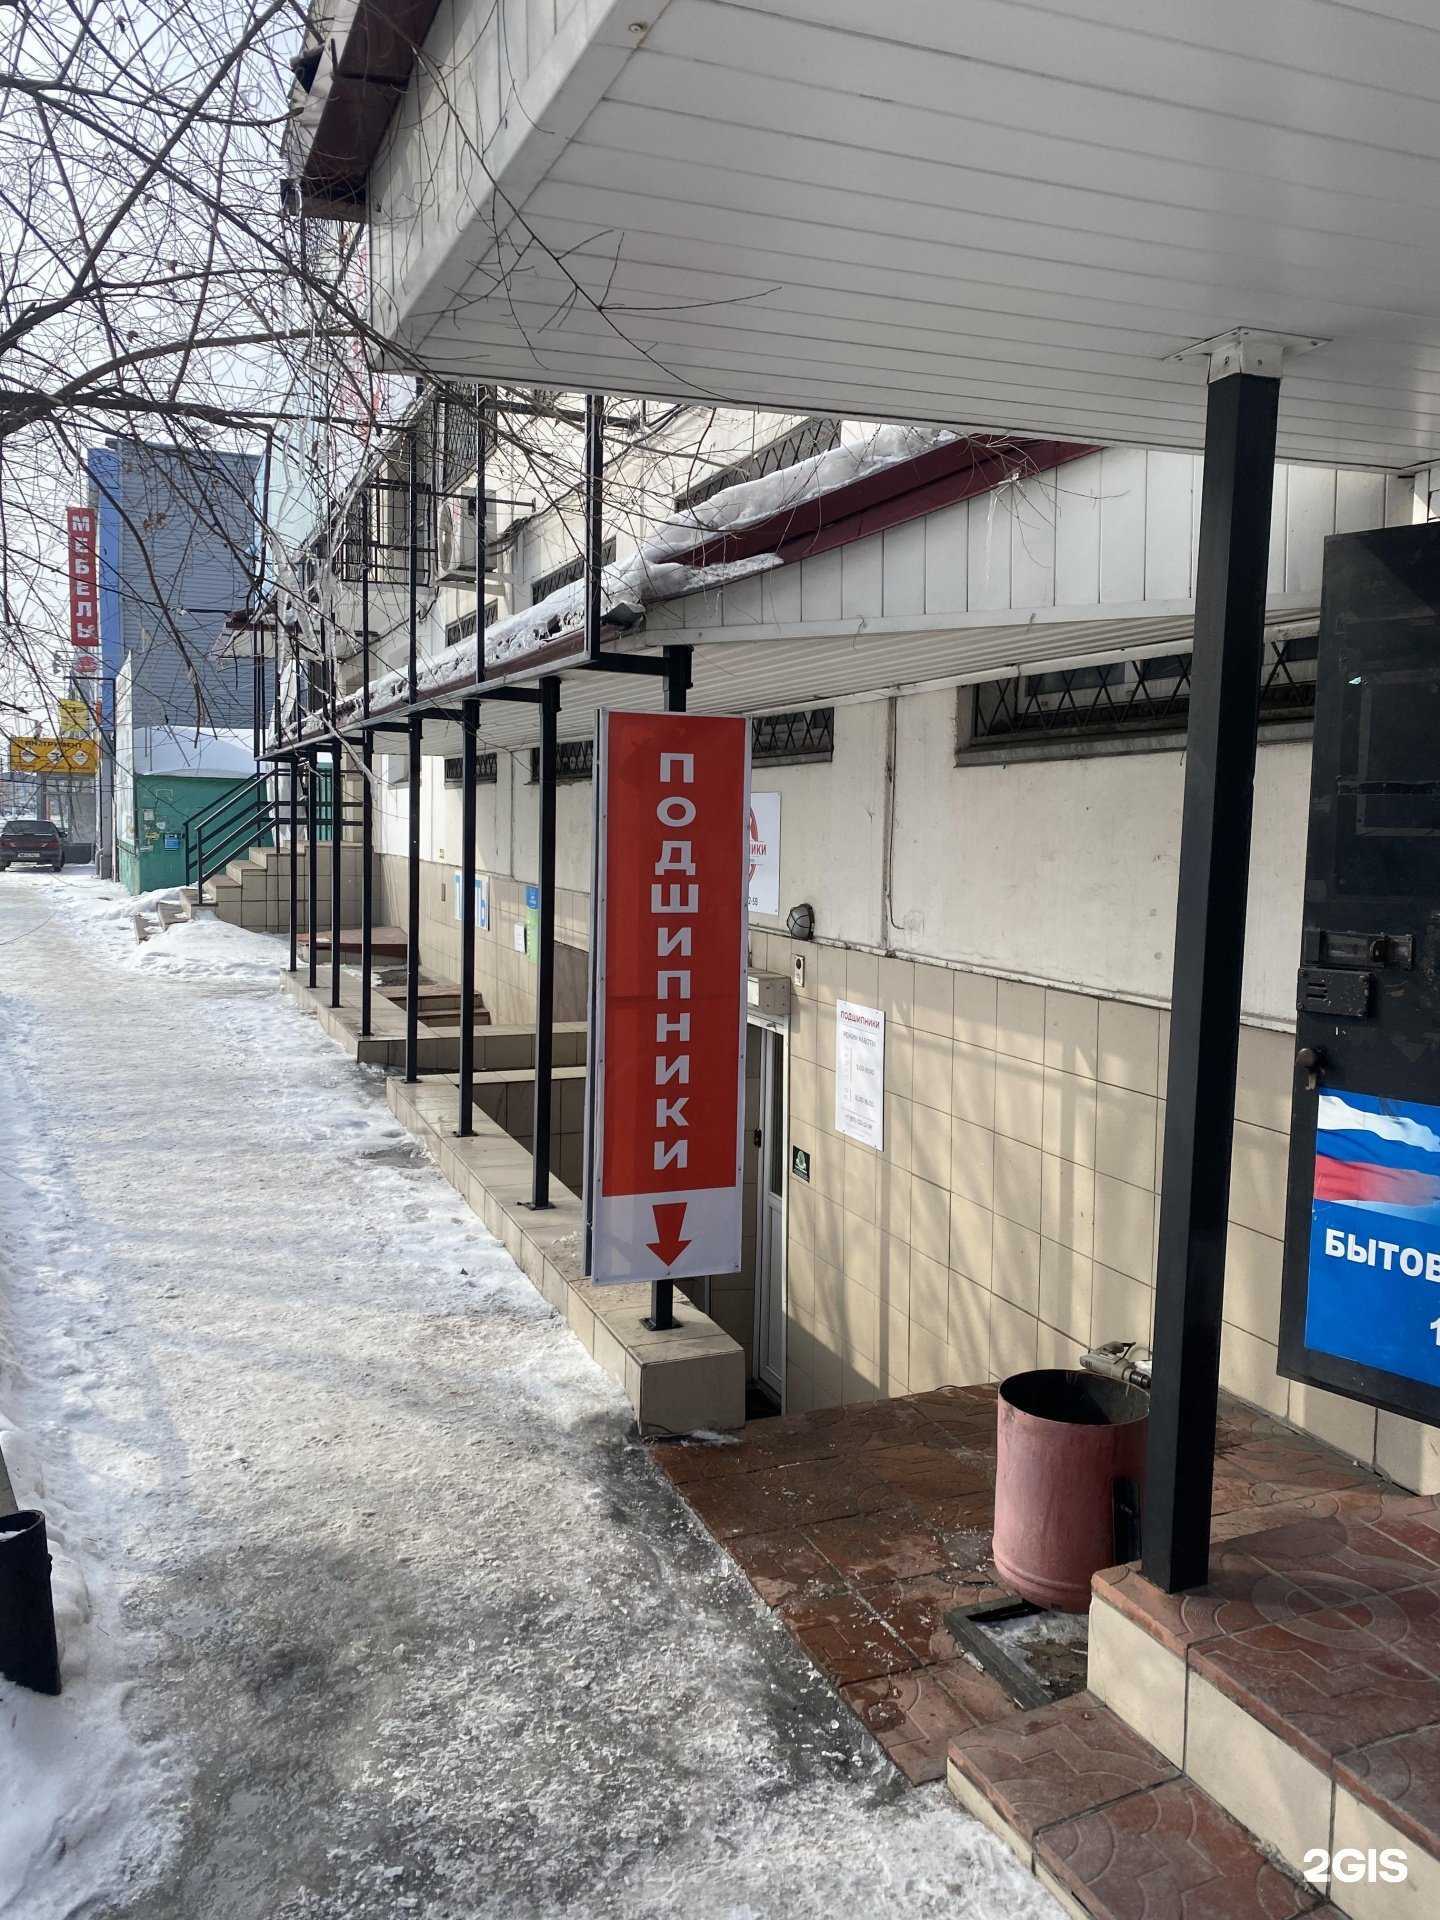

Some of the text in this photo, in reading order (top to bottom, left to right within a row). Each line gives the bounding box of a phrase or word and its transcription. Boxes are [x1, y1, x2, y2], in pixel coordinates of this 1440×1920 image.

[72, 515, 95, 638] МЕБЕЛЬ
[650, 752, 699, 1170] ПОДШИПНИКИ
[840, 1010, 880, 1029] ПОДШИПНИКИ
[1325, 1228, 1440, 1283] БЫТОВ
